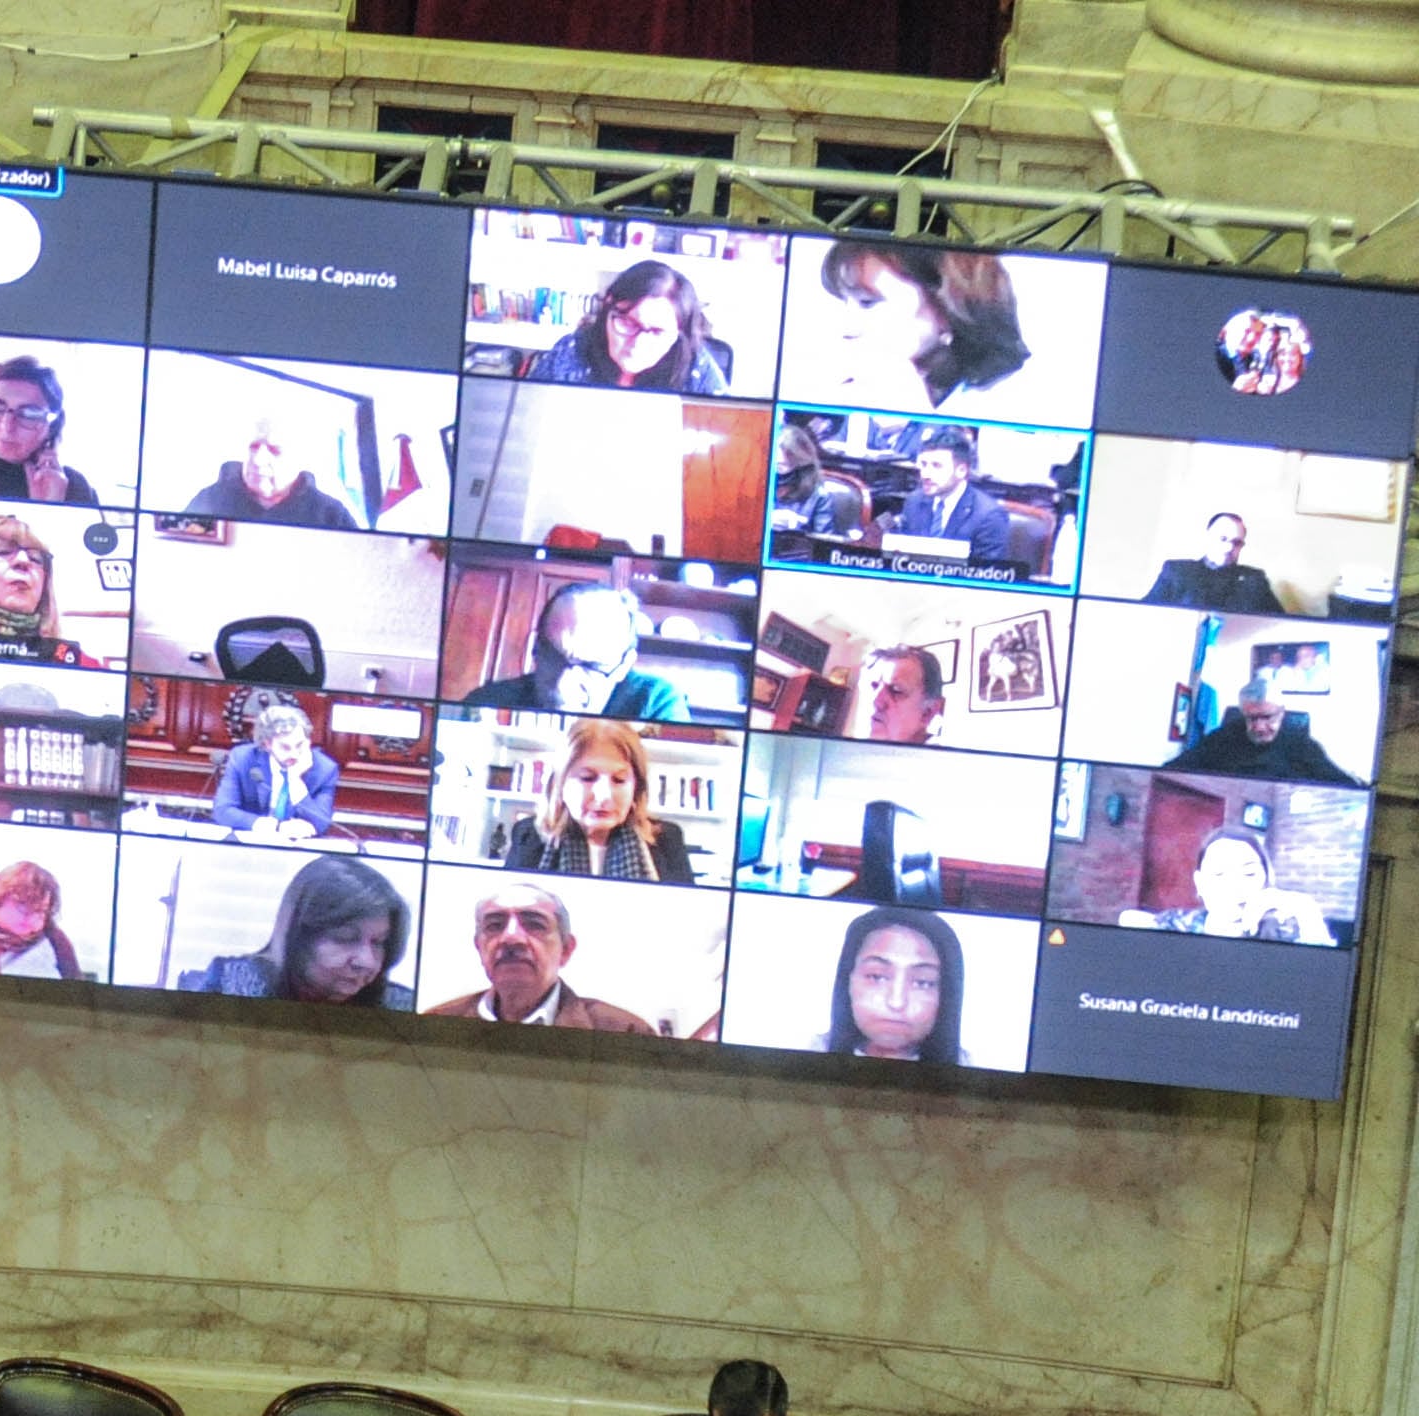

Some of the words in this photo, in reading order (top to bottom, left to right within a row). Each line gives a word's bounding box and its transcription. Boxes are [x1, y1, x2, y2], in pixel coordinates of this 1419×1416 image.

[218, 257, 270, 277] Mabel
[275, 262, 318, 282] Luisa
[321, 266, 398, 289] Caparrós
[830, 550, 884, 569] Bancas
[892, 555, 1015, 583] (Coorganizador)
[1079, 993, 1138, 1013] Susana
[1140, 998, 1209, 1020] Graciela
[1212, 1006, 1301, 1029] Landriscini
